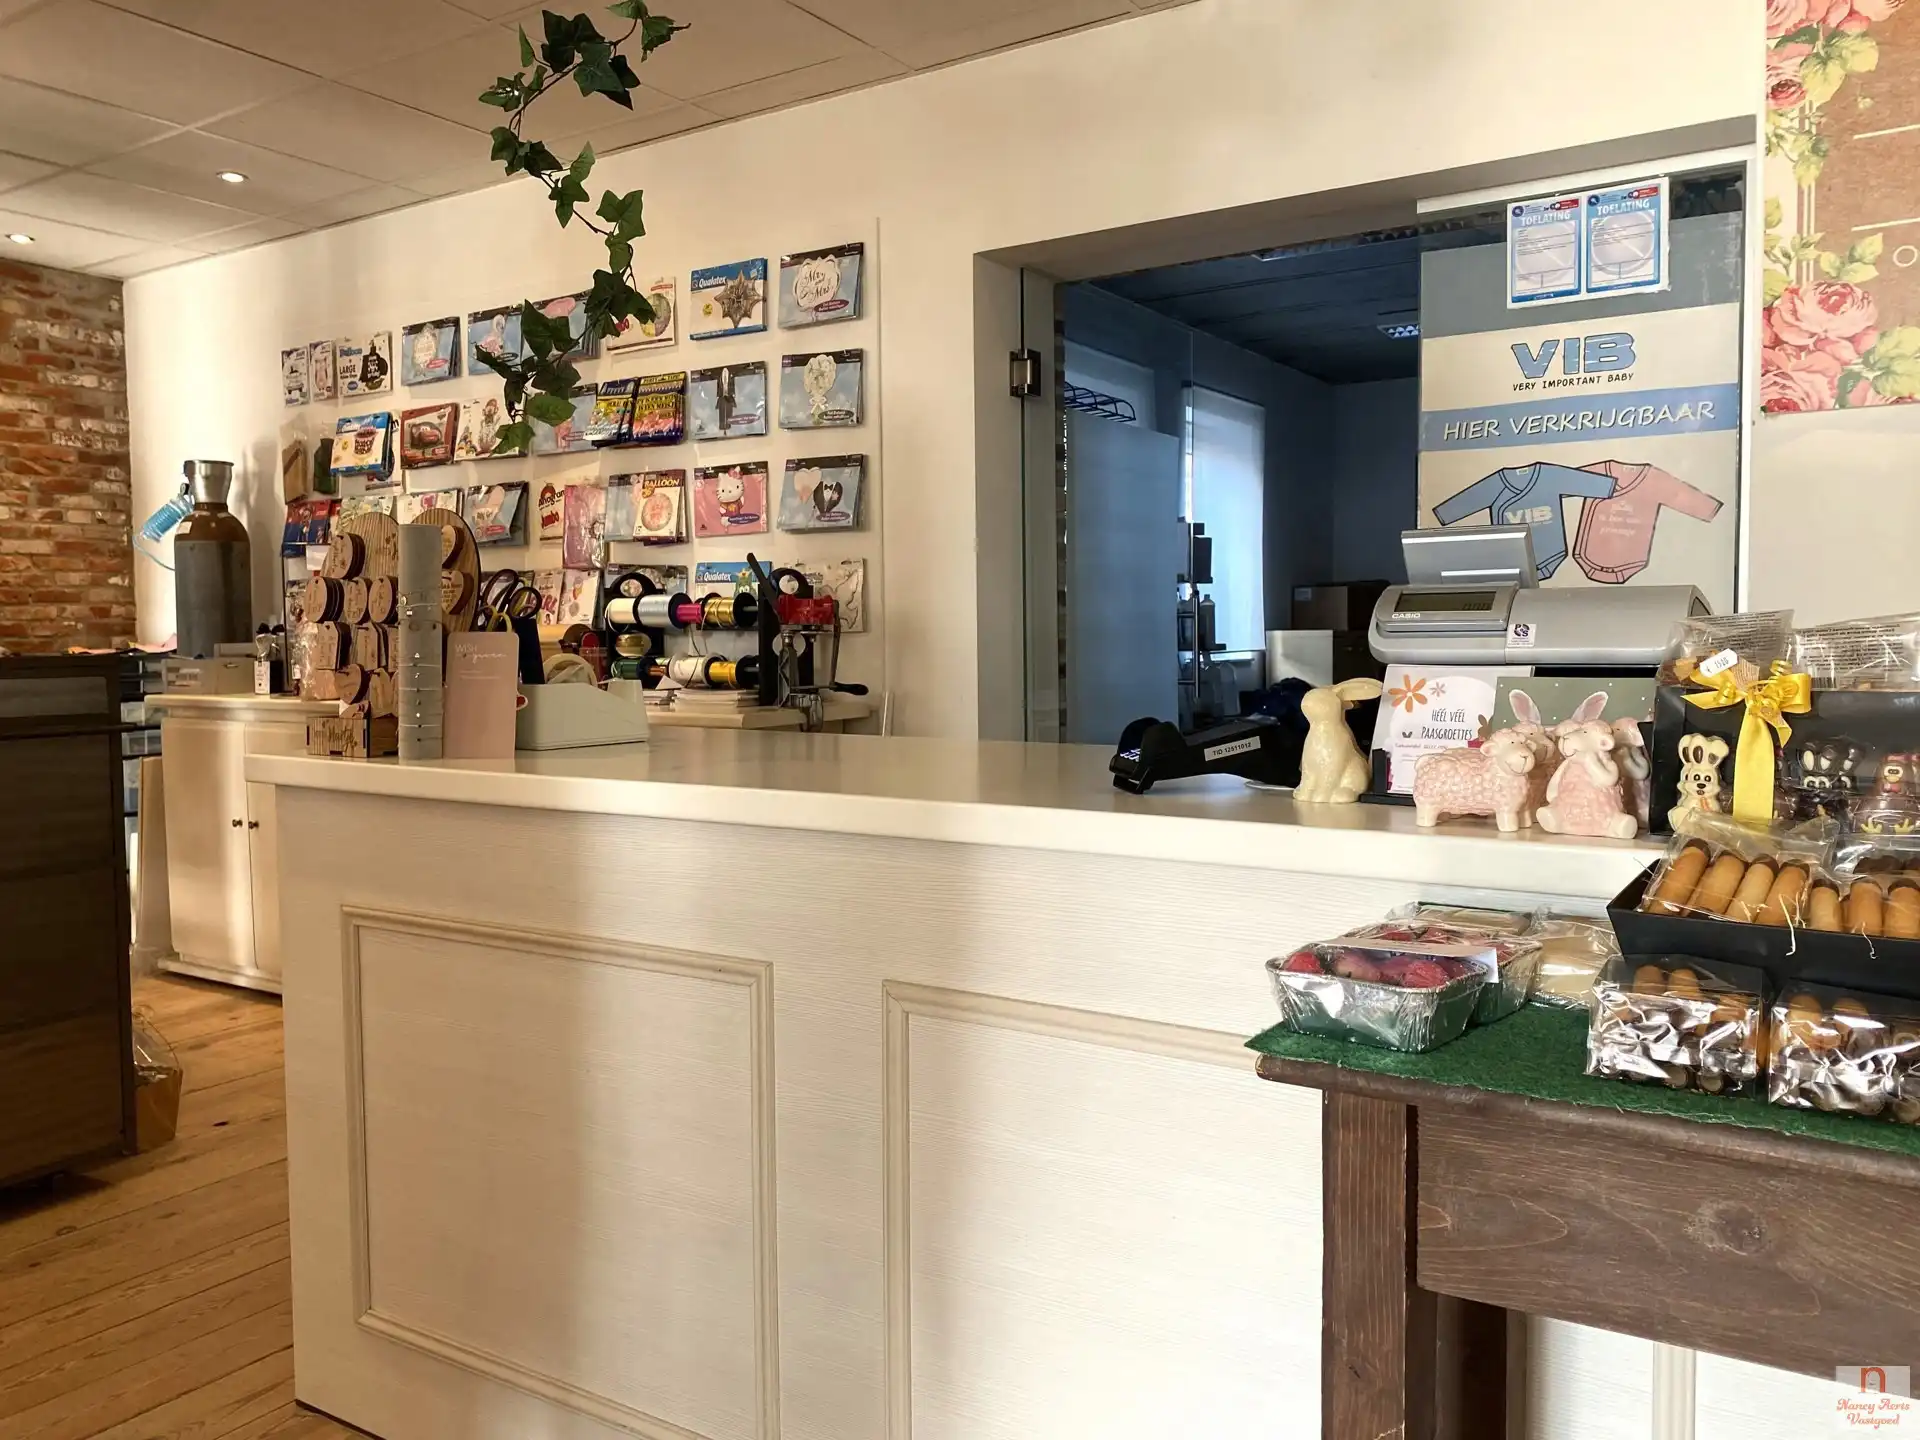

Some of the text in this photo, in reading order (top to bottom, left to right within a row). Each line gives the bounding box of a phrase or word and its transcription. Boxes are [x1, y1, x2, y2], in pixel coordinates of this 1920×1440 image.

[1597, 198, 1650, 216] TOELATING
[1521, 210, 1571, 227] TOELATING
[698, 275, 727, 289] Qualatex
[1511, 332, 1636, 379] VIB
[339, 364, 356, 375] LARGE
[1512, 372, 1635, 392] VERY IMPORTANT BABY
[1443, 400, 1716, 441] HIER VERKRIJGBAAR
[644, 479, 679, 487] BALLOON
[1504, 505, 1554, 523] VIB
[703, 570, 731, 582] Qualatex
[1431, 708, 1466, 723] HÉÉL VÉÉL
[1421, 726, 1473, 741] PAASGROETJES
